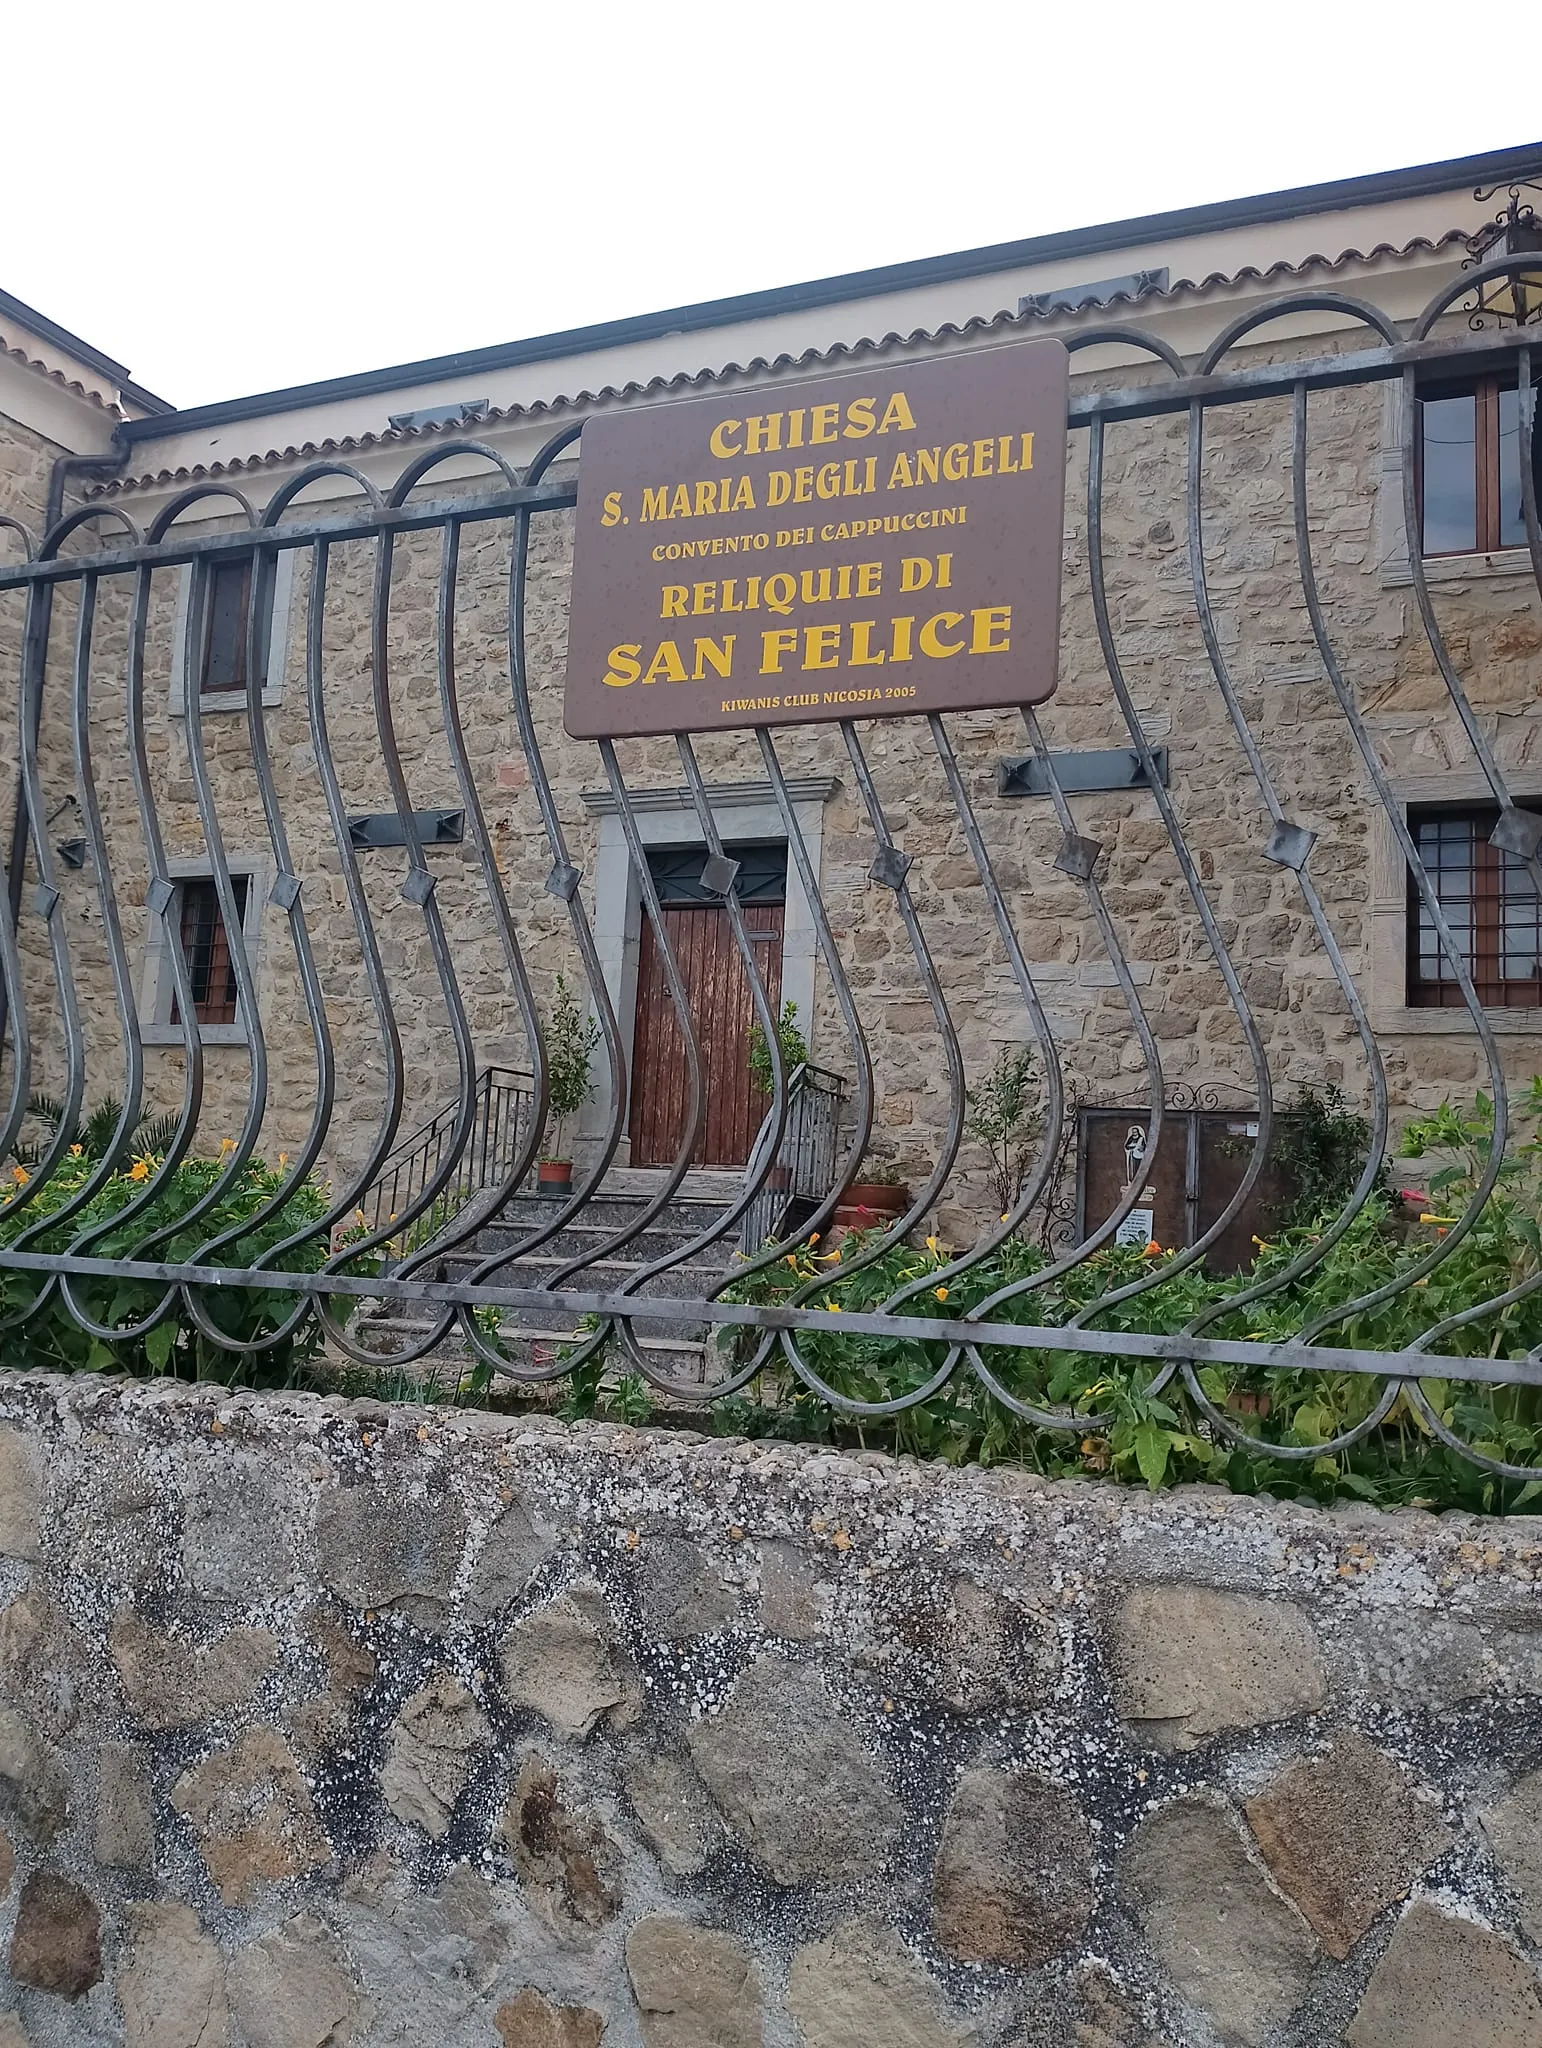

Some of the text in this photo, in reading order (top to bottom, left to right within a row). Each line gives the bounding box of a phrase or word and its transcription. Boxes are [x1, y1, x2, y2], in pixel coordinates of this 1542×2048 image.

[710, 393, 916, 459] CHIESA
[601, 432, 1034, 527] S. MARIA DEGLI ANGELI
[651, 506, 967, 562] CONVENTO DEI CAPPUCCINI
[660, 553, 953, 618] RELIQUIE DI
[602, 605, 1012, 688] SAN FELICE
[721, 686, 916, 712] KIWANIS CLUB NICOSIA 2005
